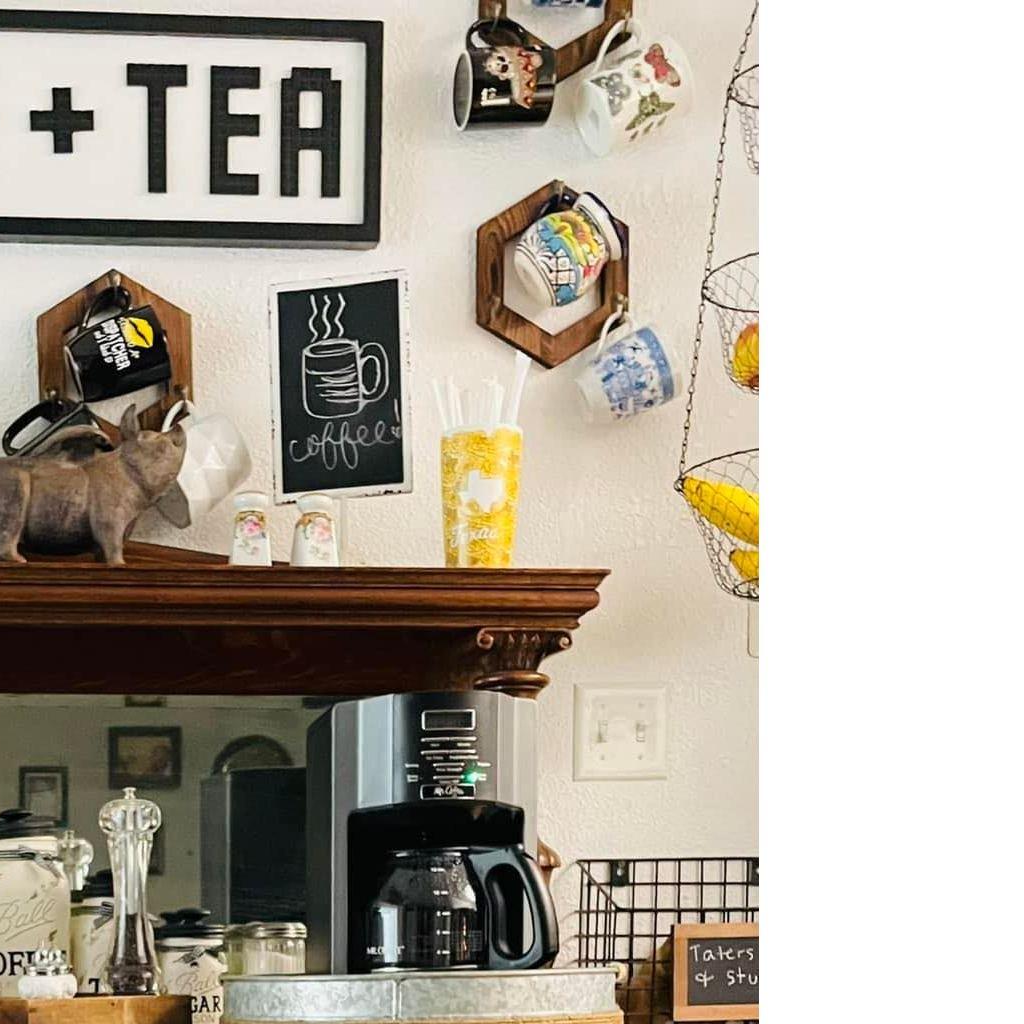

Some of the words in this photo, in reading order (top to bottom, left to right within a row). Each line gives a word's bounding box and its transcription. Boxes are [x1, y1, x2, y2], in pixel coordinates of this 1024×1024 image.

[126, 62, 343, 198] TEA
[99, 318, 131, 371] DISPATCHER
[689, 944, 754, 963] Taters
